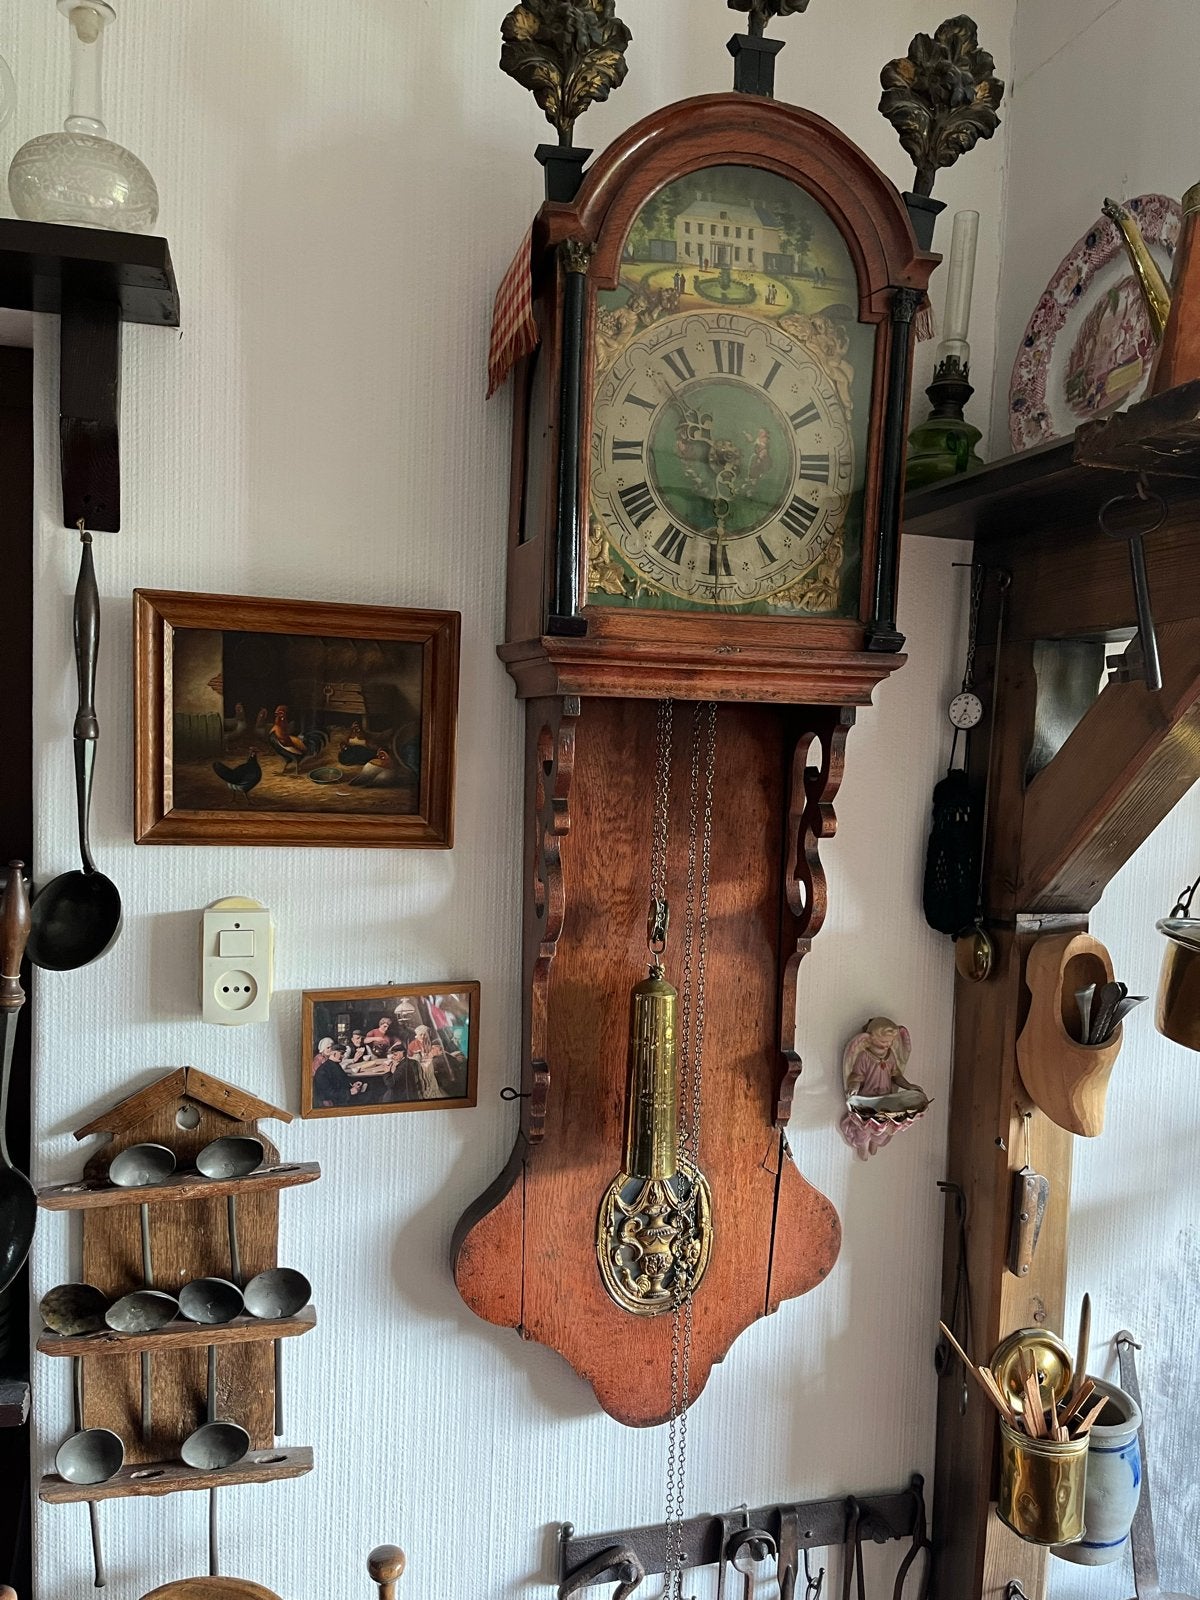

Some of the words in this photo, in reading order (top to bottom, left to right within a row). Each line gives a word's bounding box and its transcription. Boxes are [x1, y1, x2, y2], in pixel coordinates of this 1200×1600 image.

[757, 357, 785, 393] I
[785, 397, 822, 434] II
[799, 449, 830, 486] III
[779, 494, 820, 540] IIII
